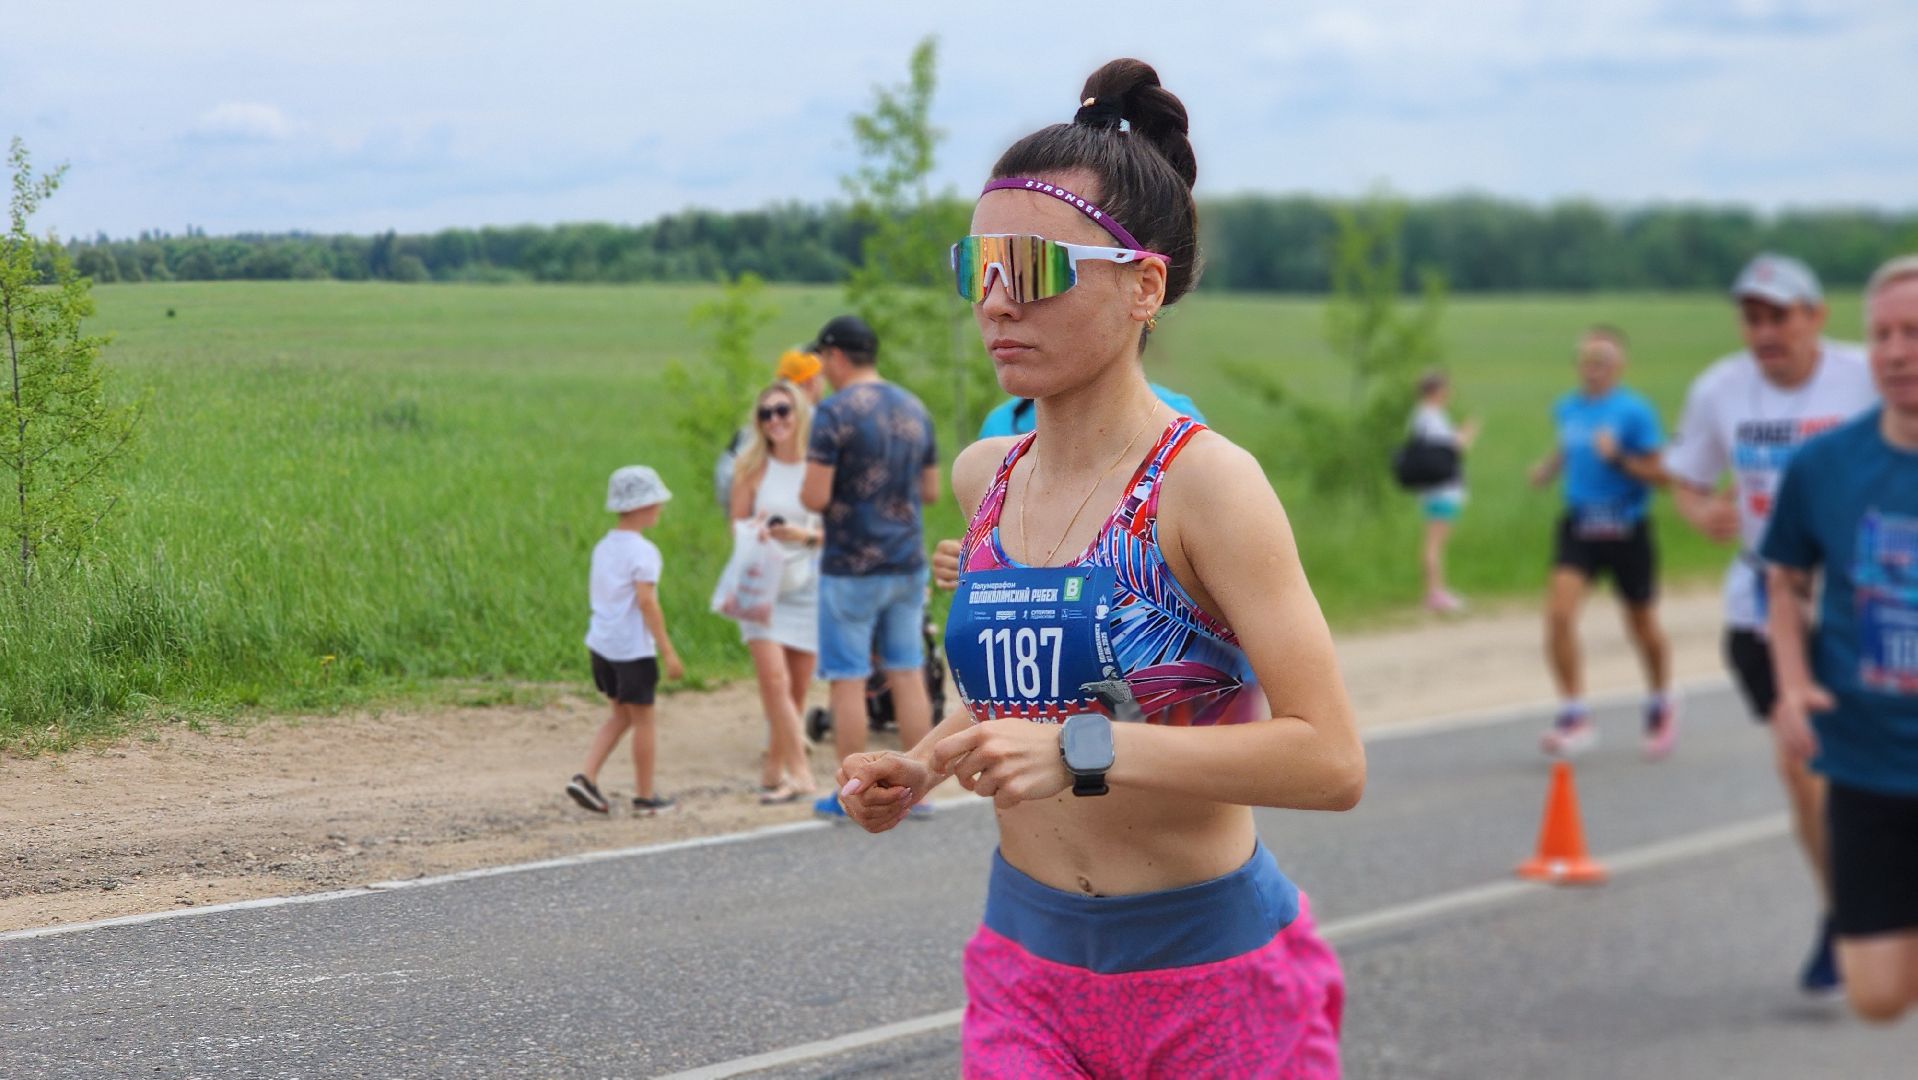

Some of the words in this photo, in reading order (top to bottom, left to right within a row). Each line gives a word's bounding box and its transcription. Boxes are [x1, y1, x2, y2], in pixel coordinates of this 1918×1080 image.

[1025, 180, 1102, 219] STRONGER
[972, 582, 1016, 590] Полумарафон
[1031, 589, 1059, 602] РУБЕЖ
[978, 627, 1063, 699] 1187
